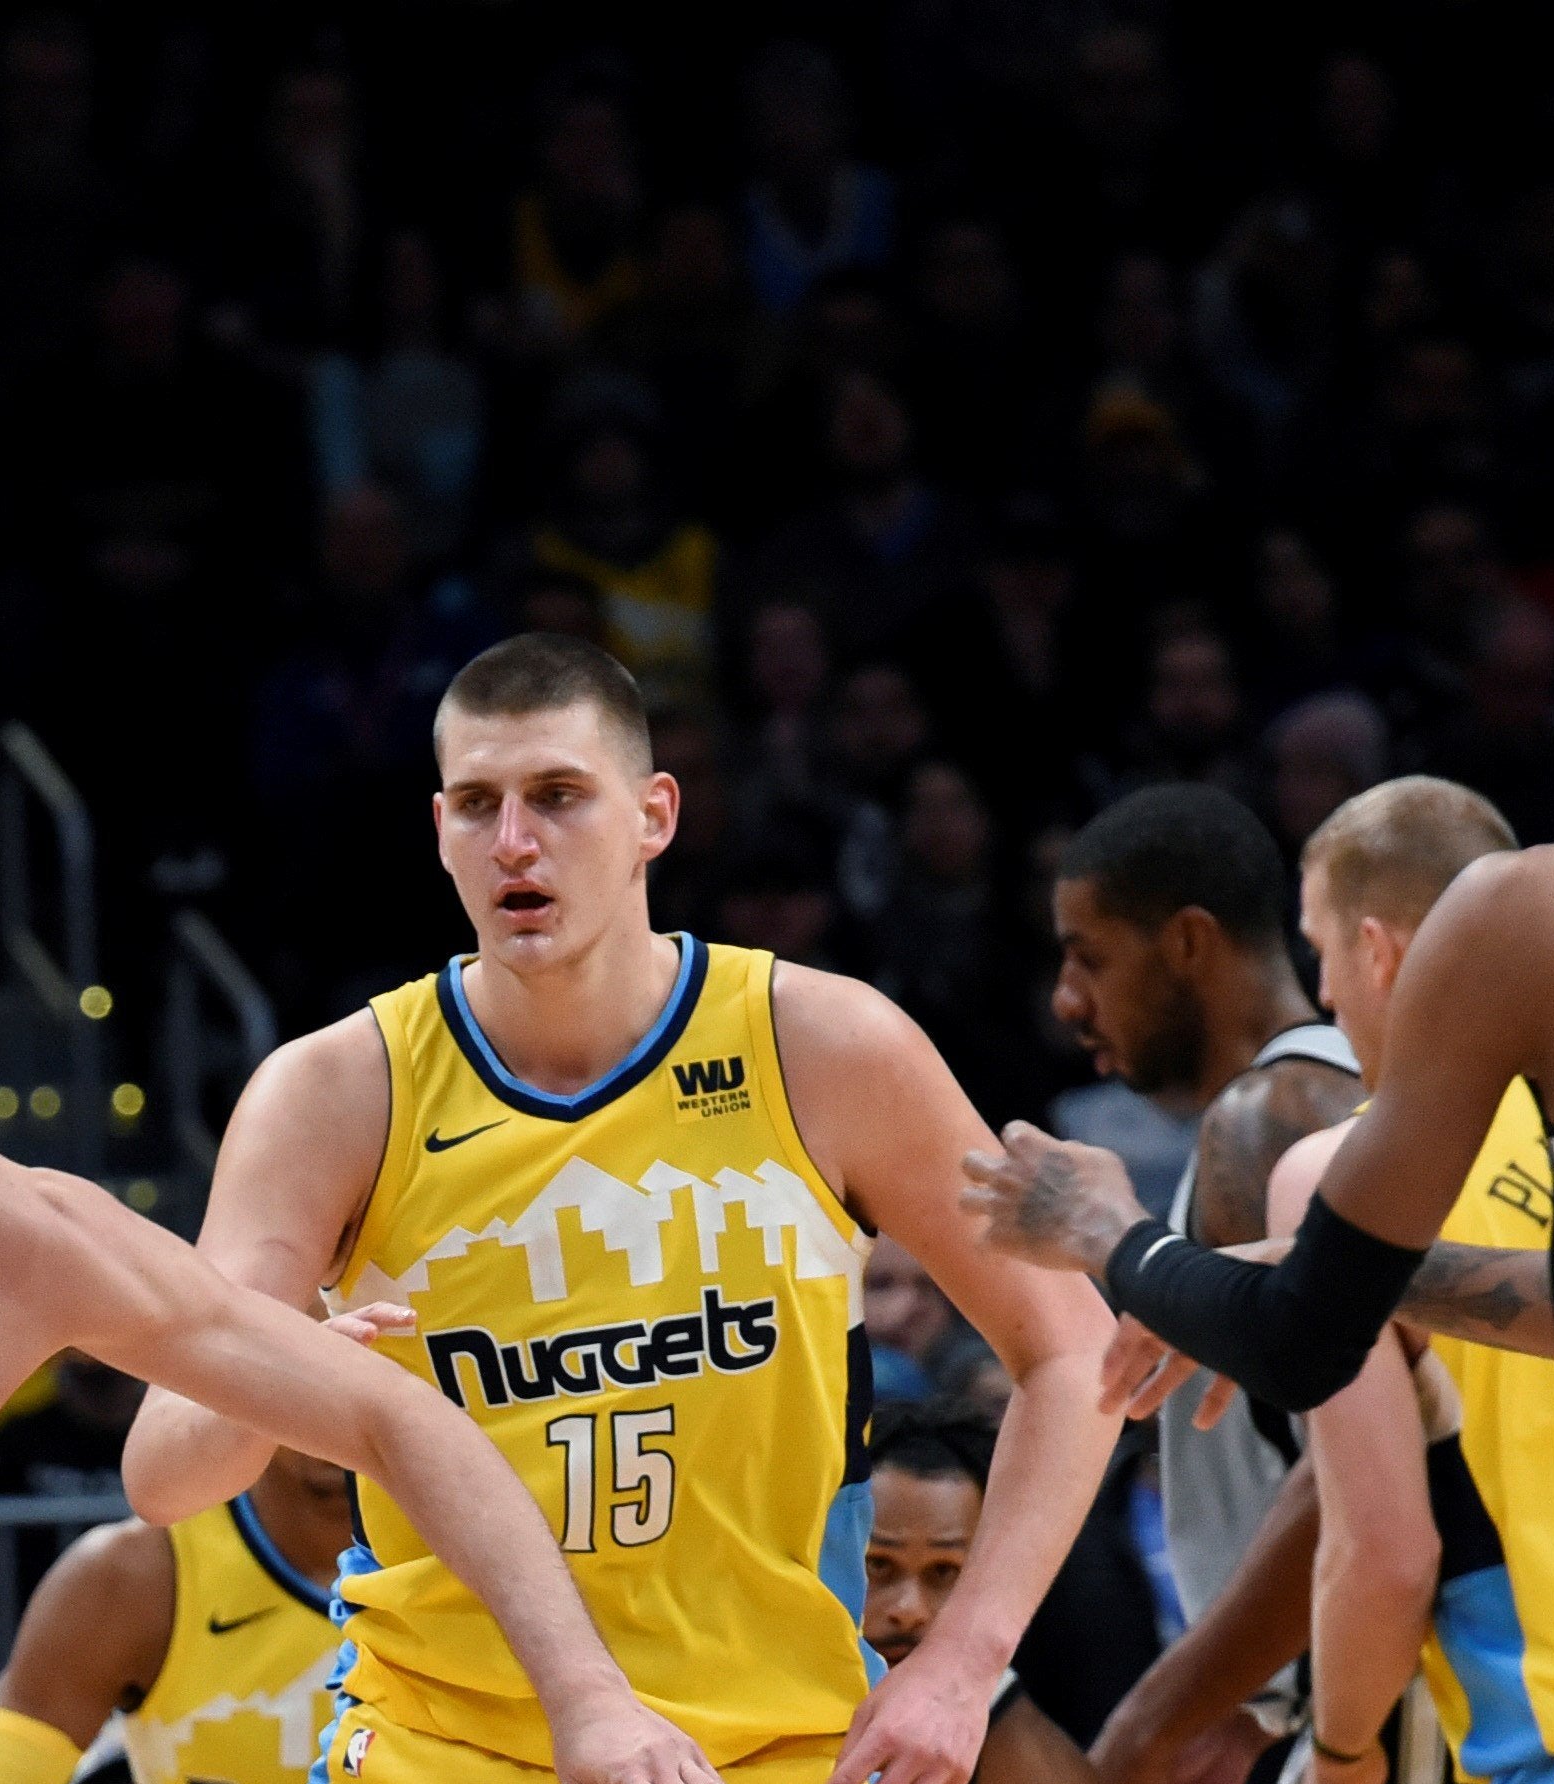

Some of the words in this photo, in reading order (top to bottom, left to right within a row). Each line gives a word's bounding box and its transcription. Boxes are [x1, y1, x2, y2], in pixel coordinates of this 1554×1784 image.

[671, 1055, 745, 1097] WU
[677, 1089, 749, 1111] WESTERN
[700, 1100, 751, 1118] UNION
[546, 1403, 675, 1553] 15
